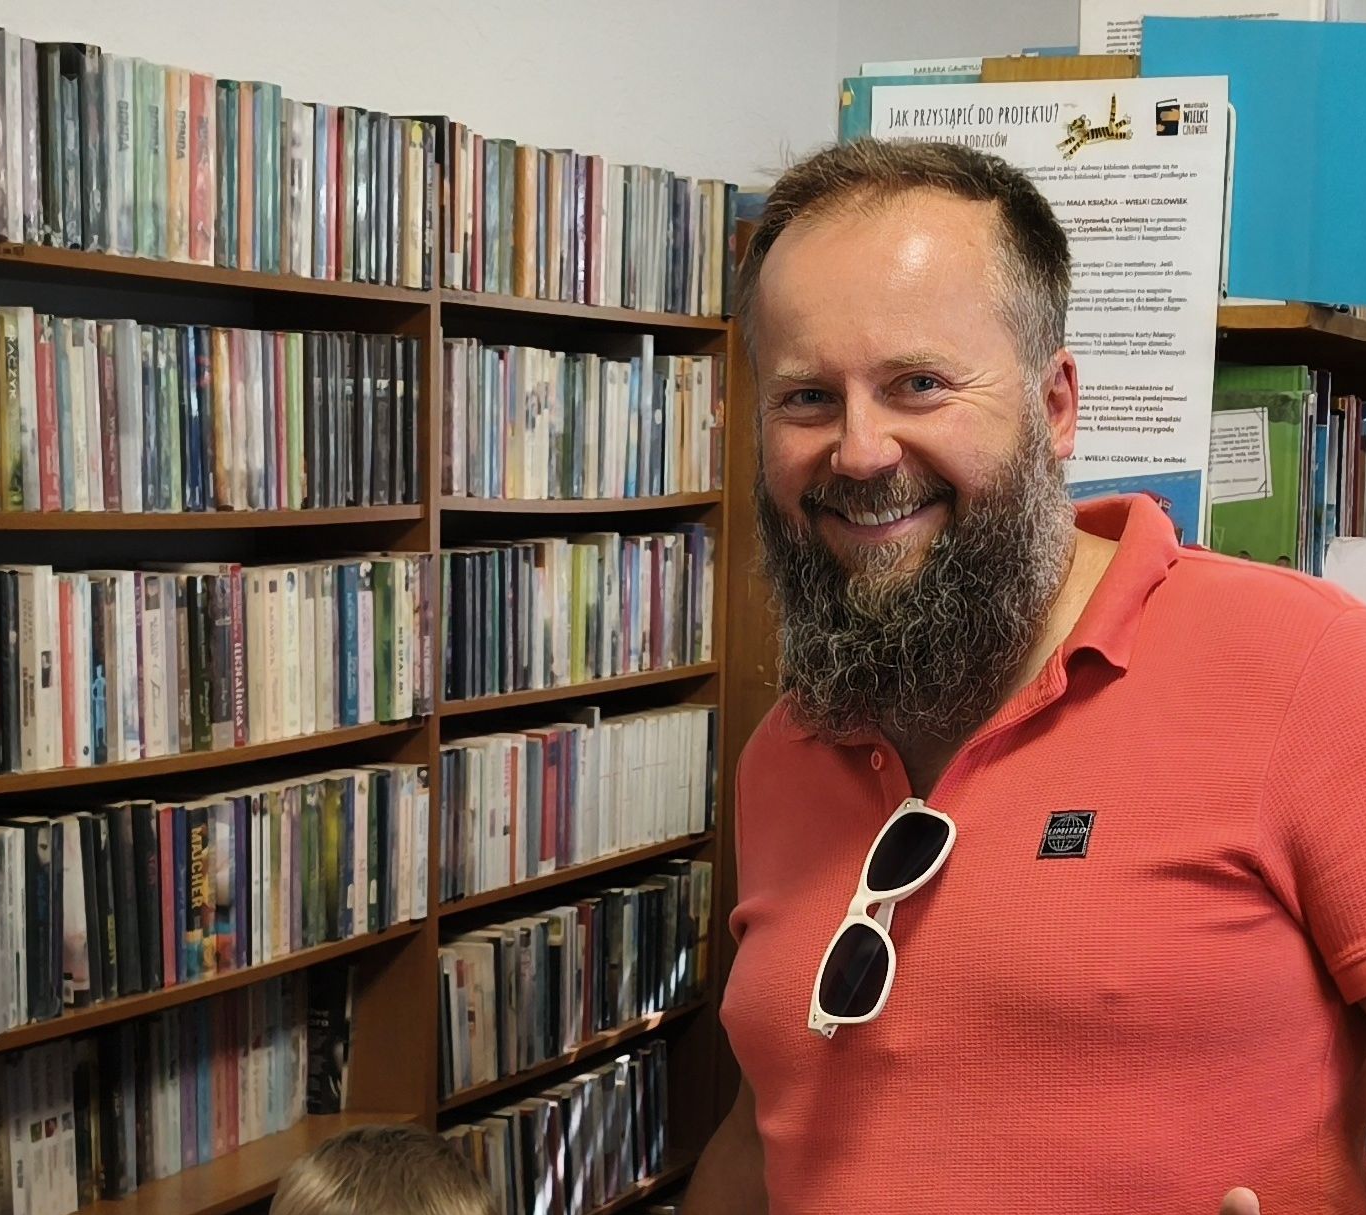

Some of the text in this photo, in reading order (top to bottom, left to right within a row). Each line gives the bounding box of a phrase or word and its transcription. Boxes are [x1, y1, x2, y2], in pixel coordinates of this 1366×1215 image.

[913, 103, 975, 129] PRZYSTĄPIĆ
[978, 107, 994, 125] DO
[998, 102, 1059, 126] PROJEKTU?
[1183, 109, 1209, 124] WIELKI
[964, 131, 1008, 148] RODZICÓW
[1066, 198, 1188, 207] MAŁA KSIĄŻKA WIELKI CZŁOWIEK
[1048, 827, 1087, 835] LIMITED
[191, 827, 204, 909] MAJCHER
